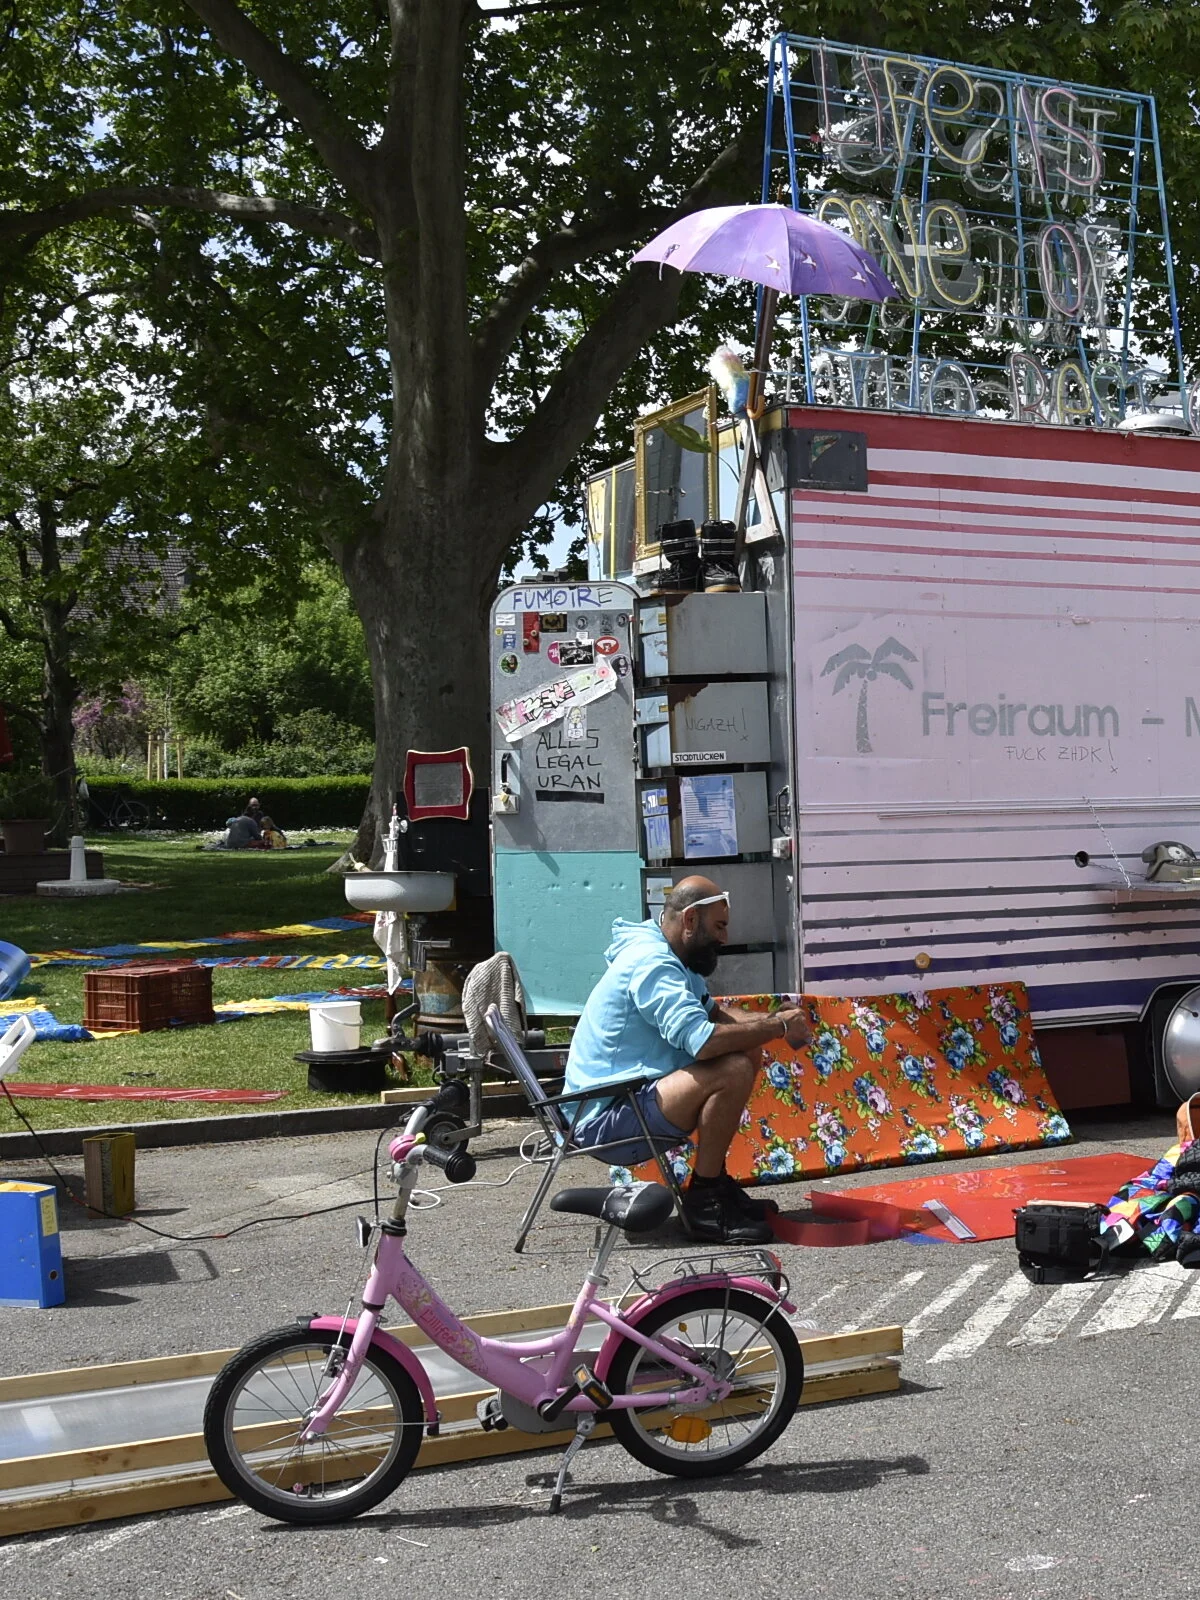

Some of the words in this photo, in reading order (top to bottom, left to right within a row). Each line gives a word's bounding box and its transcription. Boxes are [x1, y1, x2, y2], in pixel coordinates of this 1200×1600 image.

[922, 692, 1119, 737] Freiraum
[536, 729, 600, 753] ALLS
[536, 754, 602, 772] LEGAL
[1004, 746, 1046, 761] FUCK
[537, 772, 601, 791] URAN
